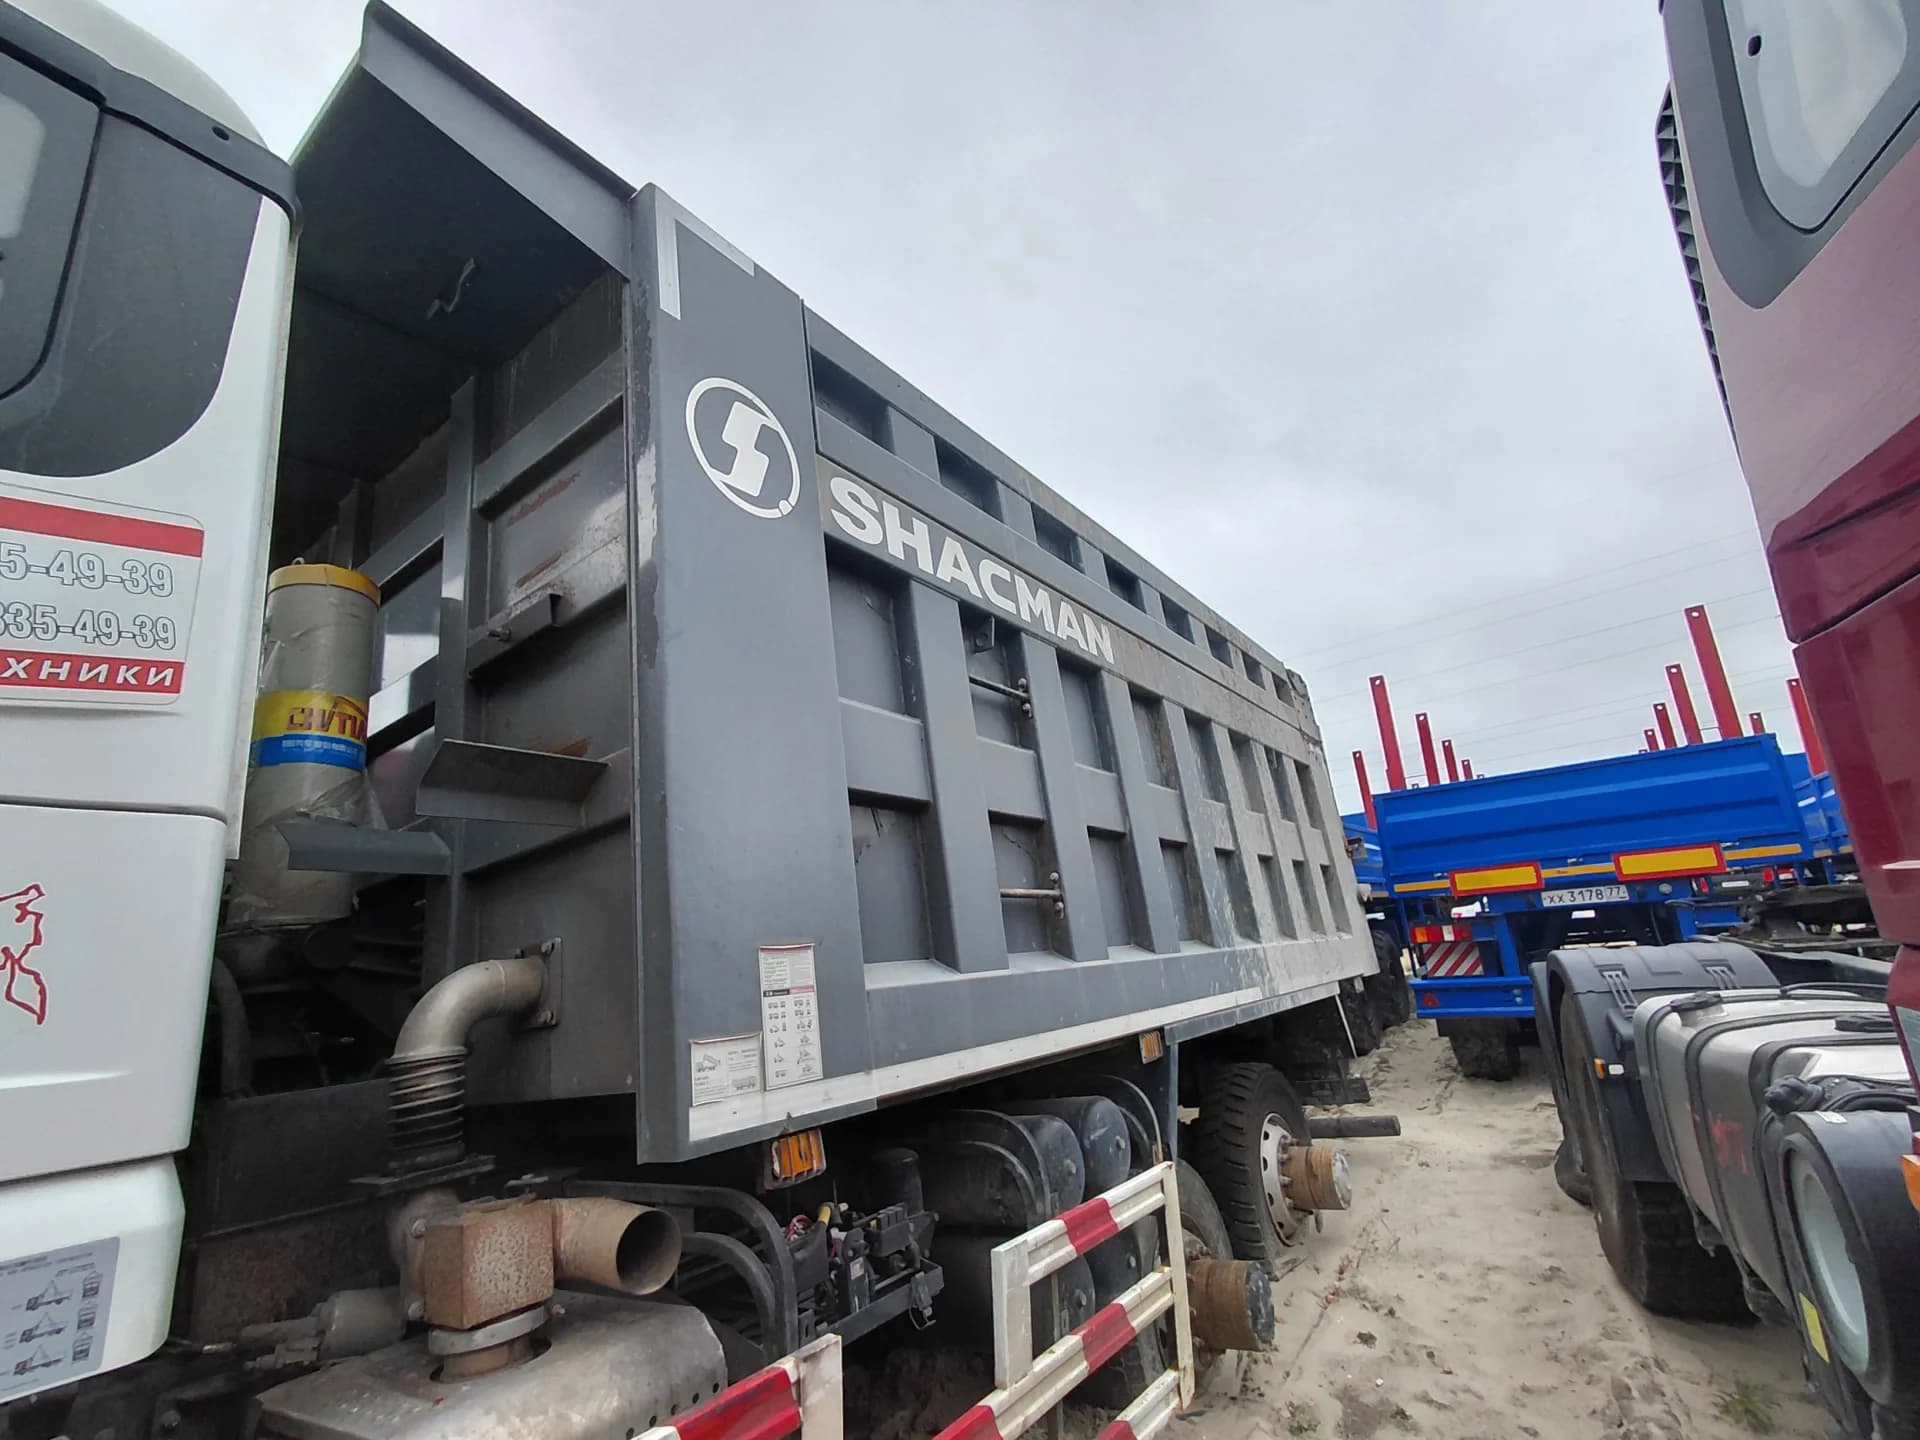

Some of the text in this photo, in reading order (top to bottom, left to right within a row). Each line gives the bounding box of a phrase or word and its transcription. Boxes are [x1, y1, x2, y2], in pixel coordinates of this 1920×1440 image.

[0, 541, 174, 597] 5-49-39
[829, 476, 1115, 665] SHACMAN
[0, 601, 176, 650] 35-49-39
